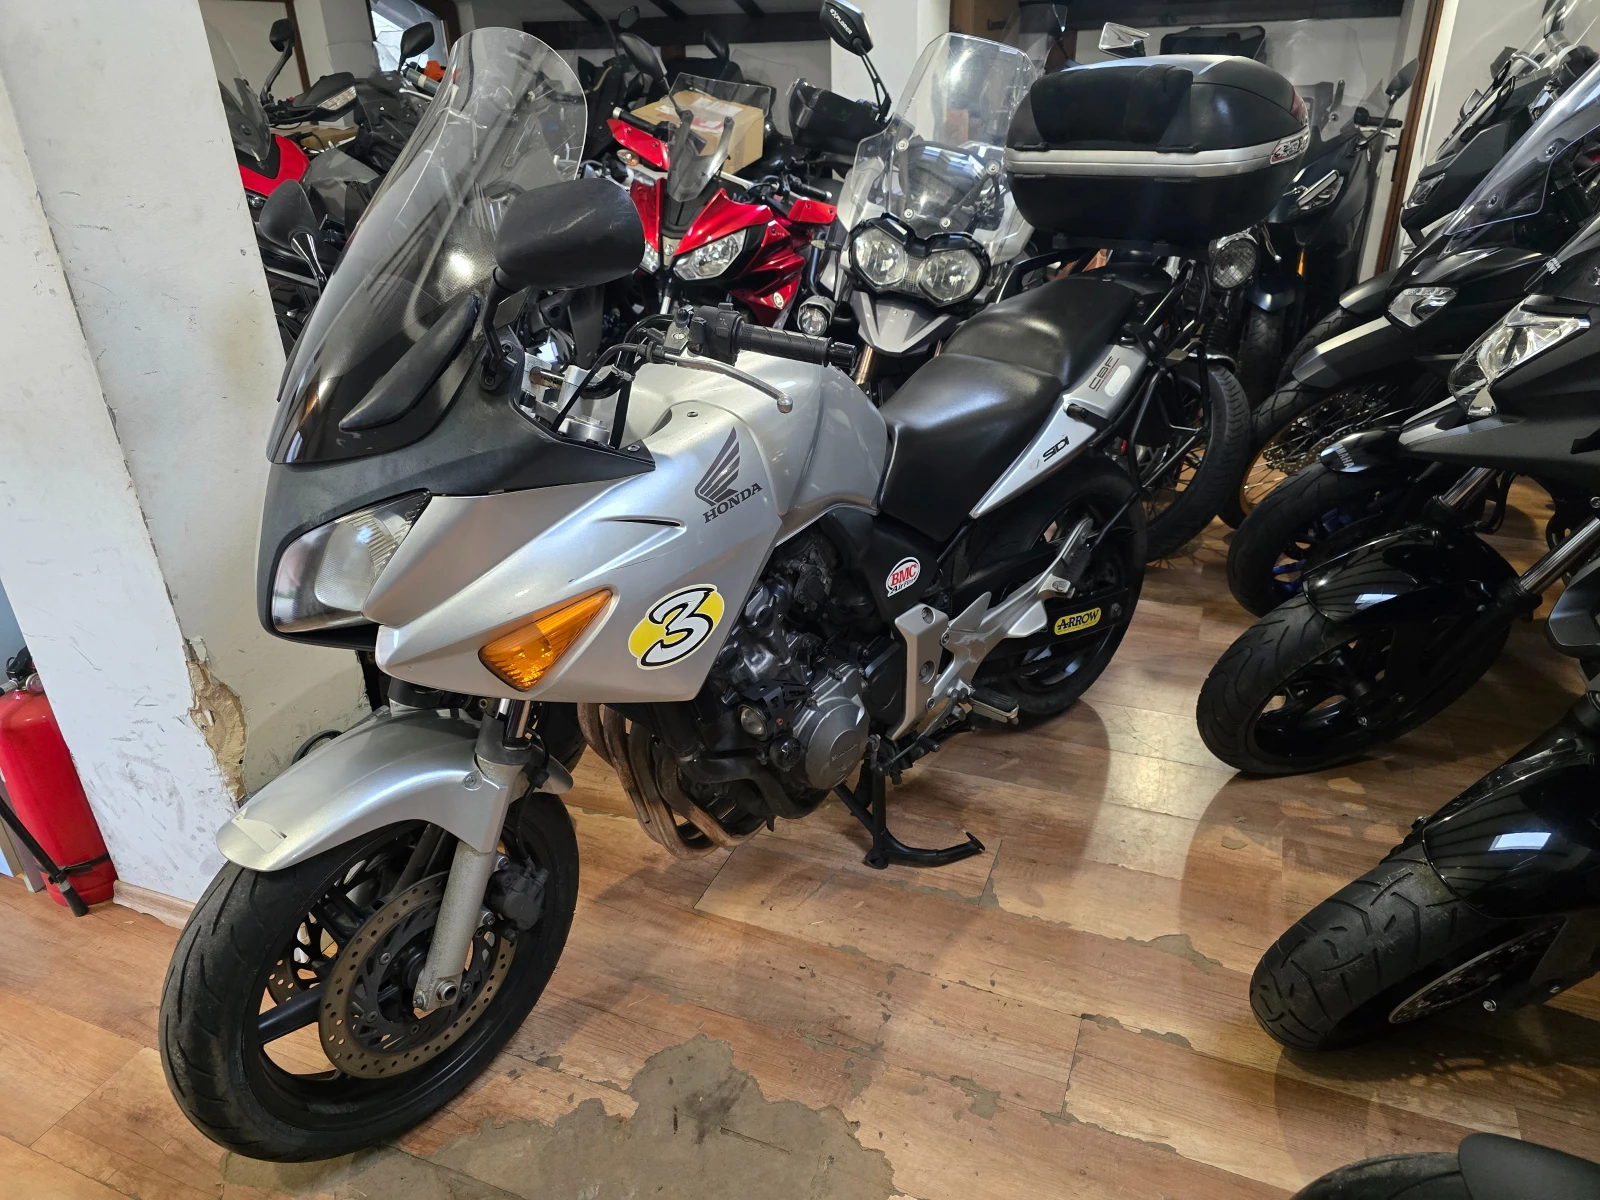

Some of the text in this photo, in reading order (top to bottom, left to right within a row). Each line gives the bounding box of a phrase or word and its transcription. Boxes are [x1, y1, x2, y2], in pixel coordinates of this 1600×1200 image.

[829, 8, 853, 35] EXPLORER
[1089, 355, 1114, 390] CBF
[702, 482, 763, 524] HONDA
[890, 563, 917, 587] BMC
[640, 587, 715, 667] 3
[1057, 608, 1100, 631] ARROW
